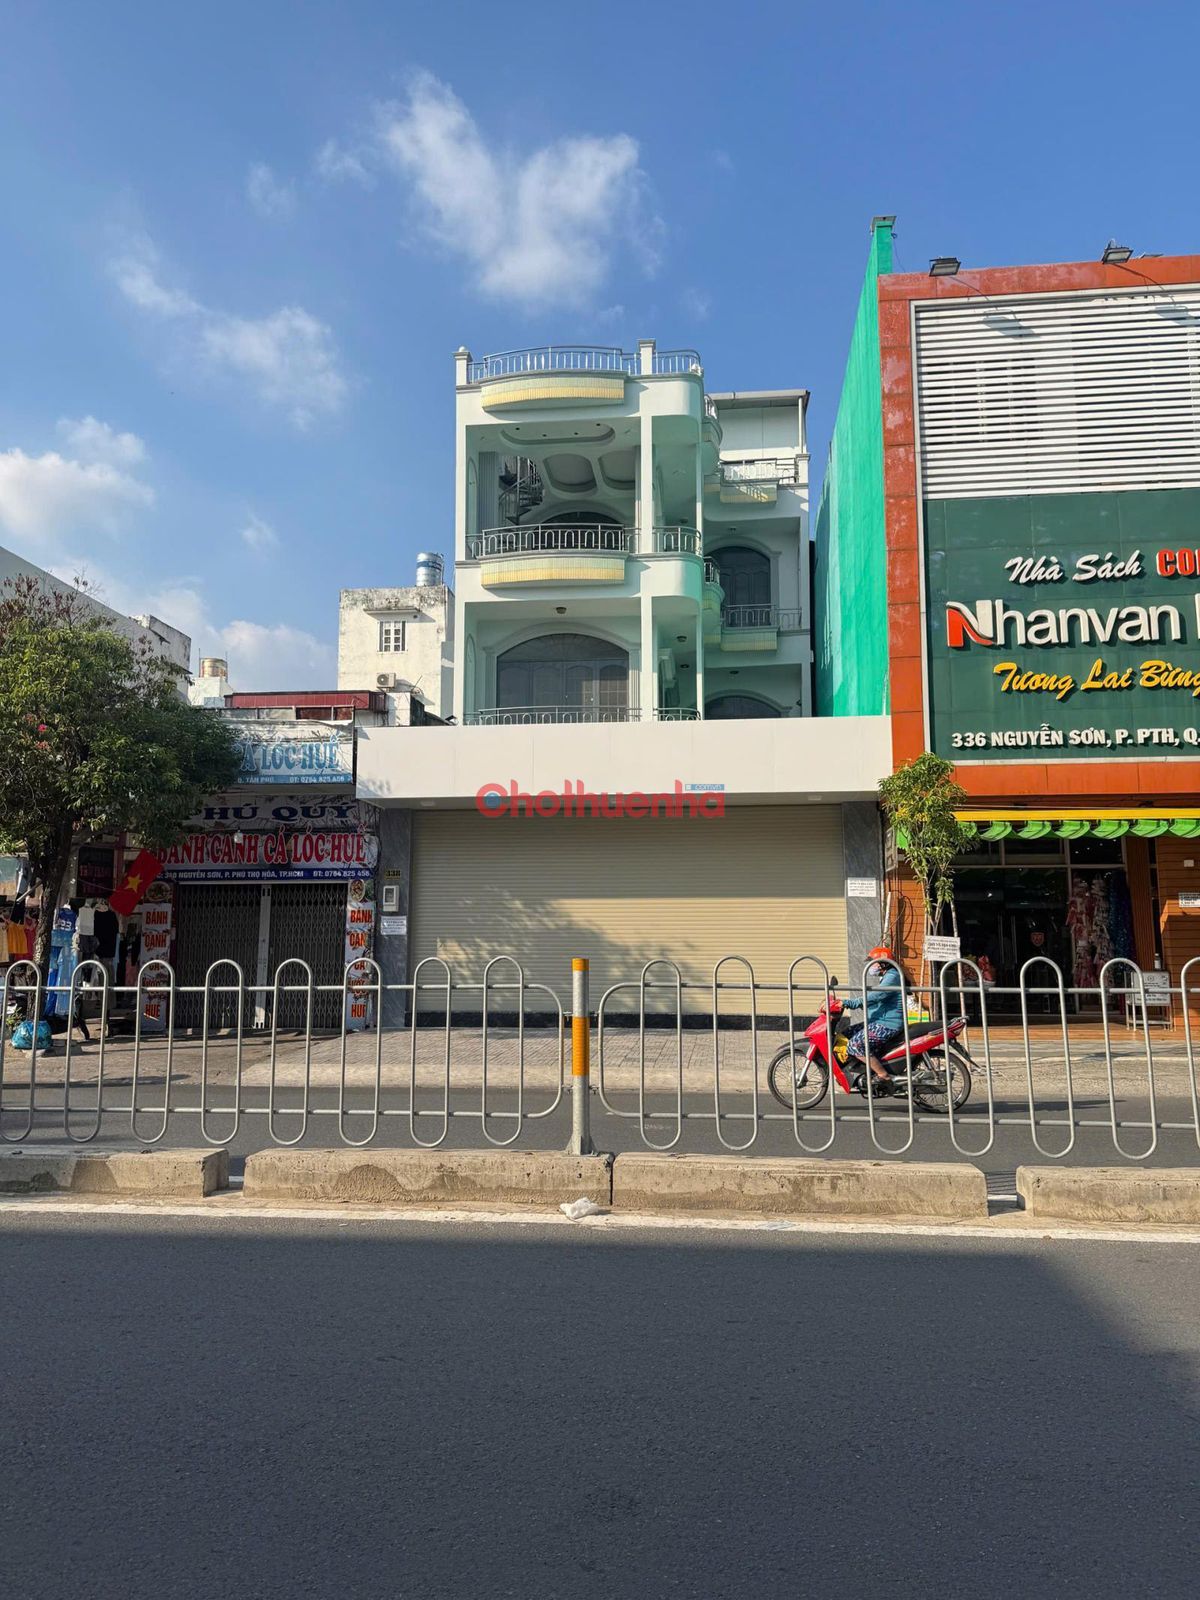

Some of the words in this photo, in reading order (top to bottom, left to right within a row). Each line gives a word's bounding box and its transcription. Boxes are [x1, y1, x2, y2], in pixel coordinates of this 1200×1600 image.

[1004, 555, 1063, 584] Nhà
[1072, 549, 1142, 581] Sách
[946, 598, 1180, 647] Nhanvan
[993, 661, 1074, 700] Tương
[1080, 658, 1133, 691] Lai
[951, 732, 986, 747] 336
[991, 723, 1063, 746] NGUYỄN
[1069, 727, 1112, 747] SƠN,
[1115, 729, 1133, 744] P.
[1137, 727, 1180, 746] PTH,
[202, 803, 260, 820] HÚ
